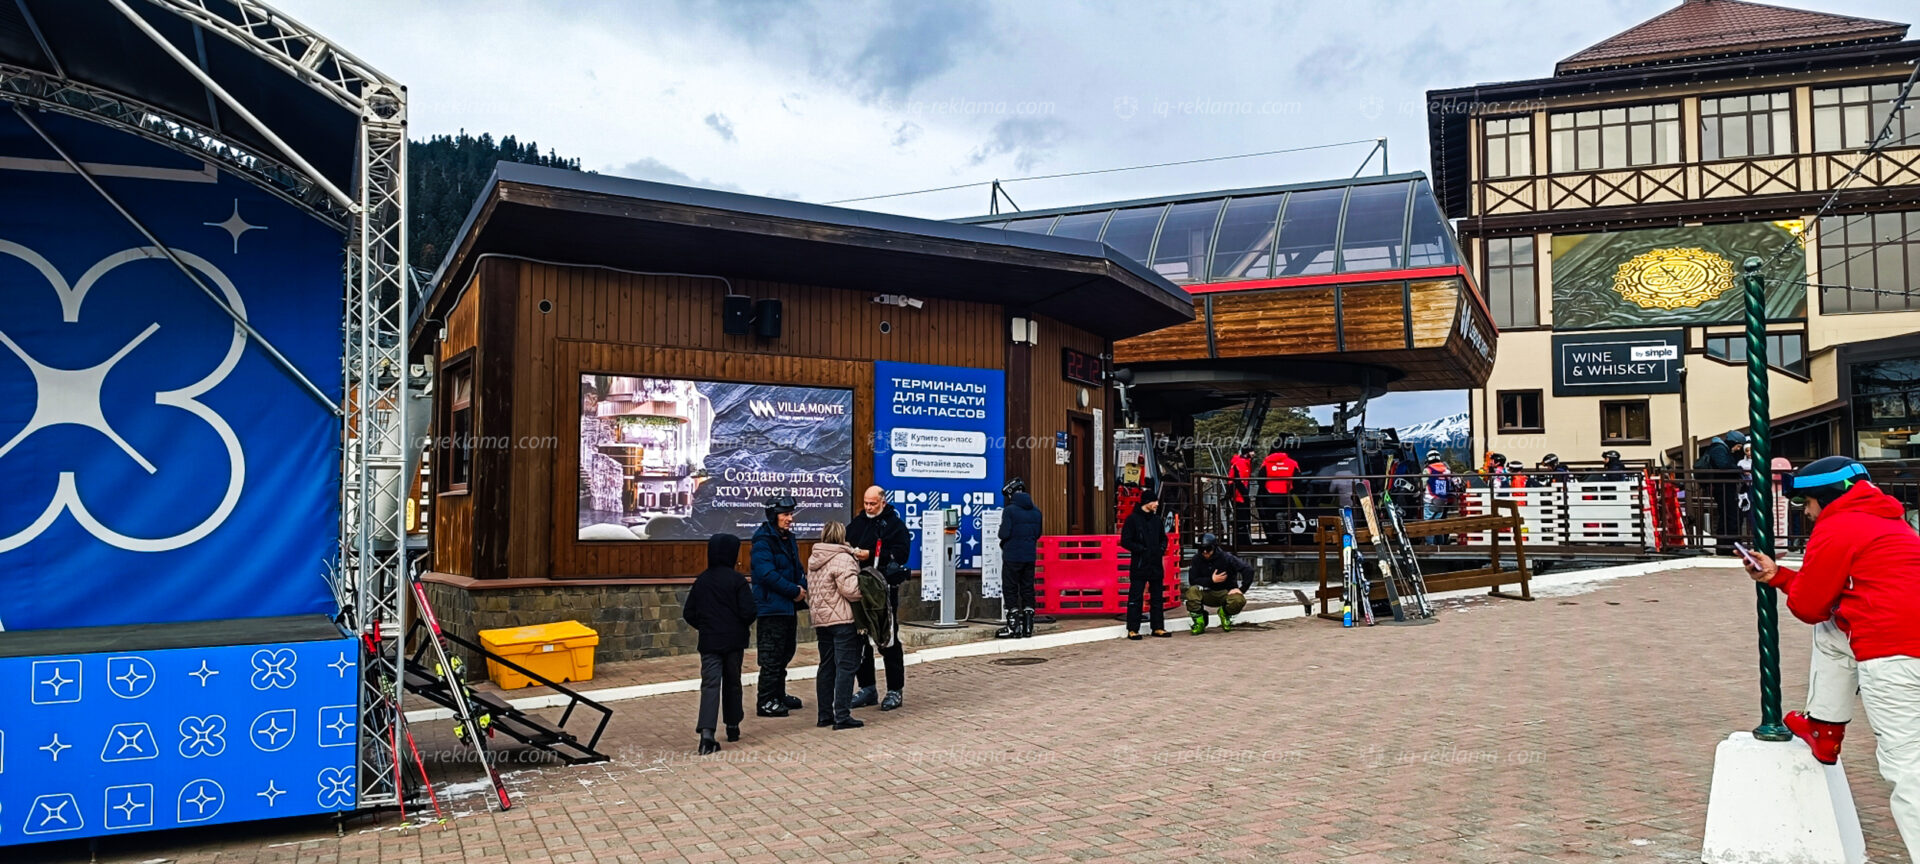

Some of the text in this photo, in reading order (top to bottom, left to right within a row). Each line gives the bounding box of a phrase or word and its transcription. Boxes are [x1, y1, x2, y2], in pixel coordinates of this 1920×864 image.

[1572, 351, 1612, 364] WINE
[1645, 348, 1673, 358] simple
[1572, 363, 1657, 377] & WHISKEY
[891, 378, 987, 394] ТЕРМИНАЛЫ
[893, 391, 985, 406] ДЛЯ ПЕЧАТИ
[777, 401, 844, 415] VILLA MONTE
[892, 404, 986, 419] СКИ-ПАССОВ
[911, 433, 973, 444] Купите ски-пасс
[912, 458, 974, 469] Печатайте здесь
[724, 467, 844, 485] Создано для тех,
[715, 485, 844, 500] кто умеет владеть
[795, 501, 822, 509] аботает
